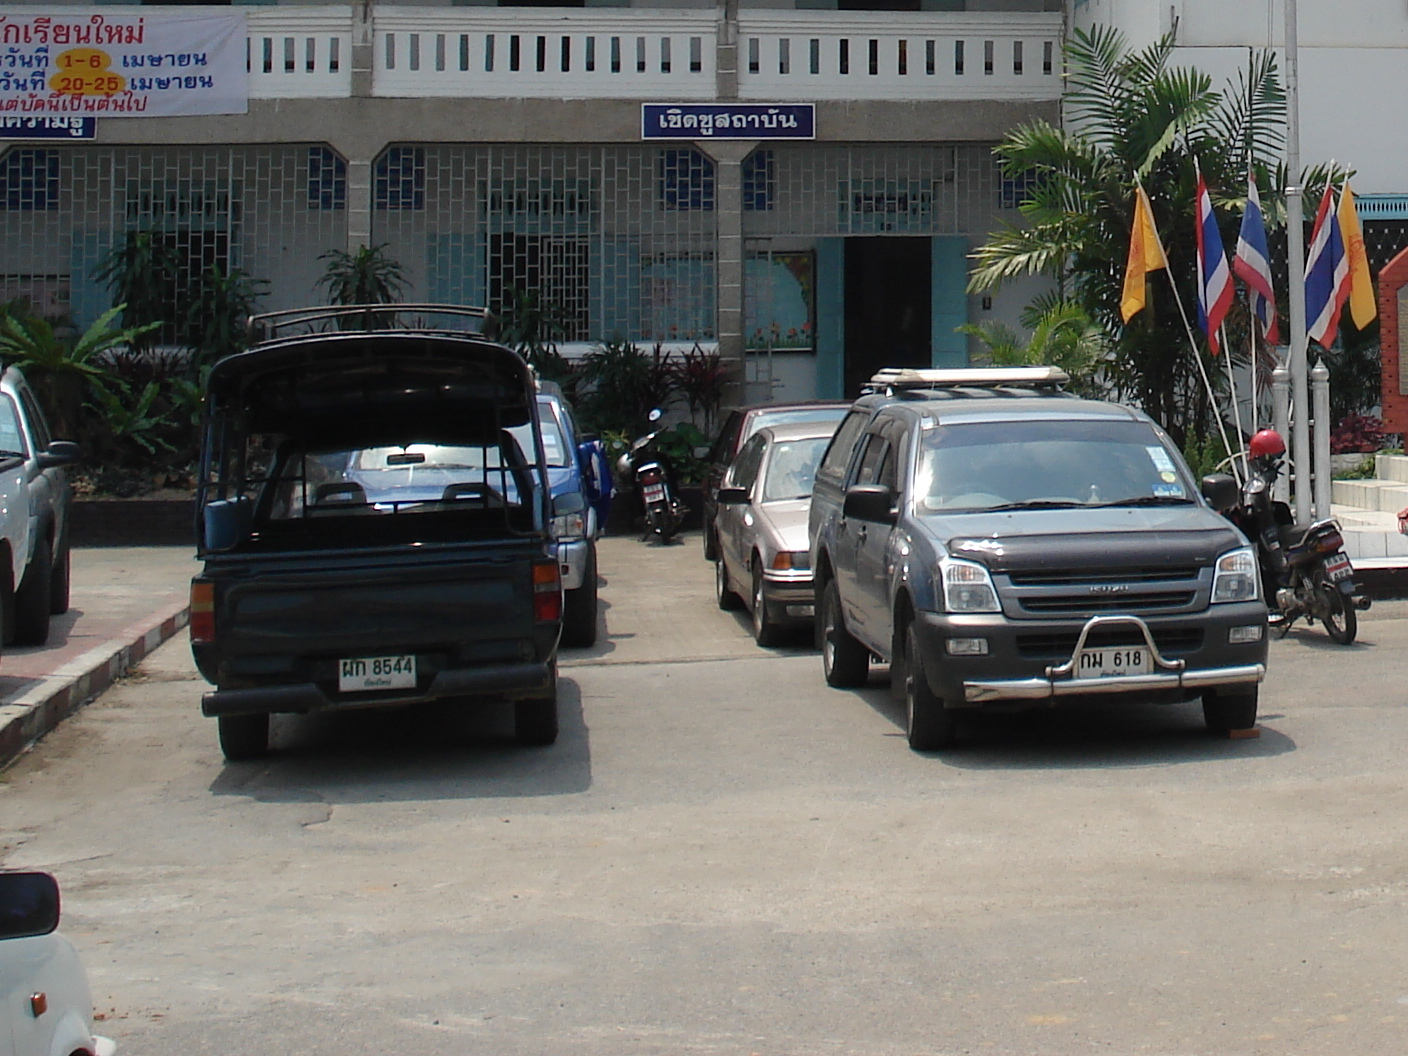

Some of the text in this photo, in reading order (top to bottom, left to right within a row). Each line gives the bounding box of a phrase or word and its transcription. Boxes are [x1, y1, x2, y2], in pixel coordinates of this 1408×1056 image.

[123, 52, 207, 68] เมษายน
[60, 77, 119, 91] 20-25
[130, 74, 214, 91] เมษายน
[659, 107, 798, 136] เชิดชูสถาบัน
[373, 657, 413, 675] 8544
[1114, 651, 1141, 667] 618
